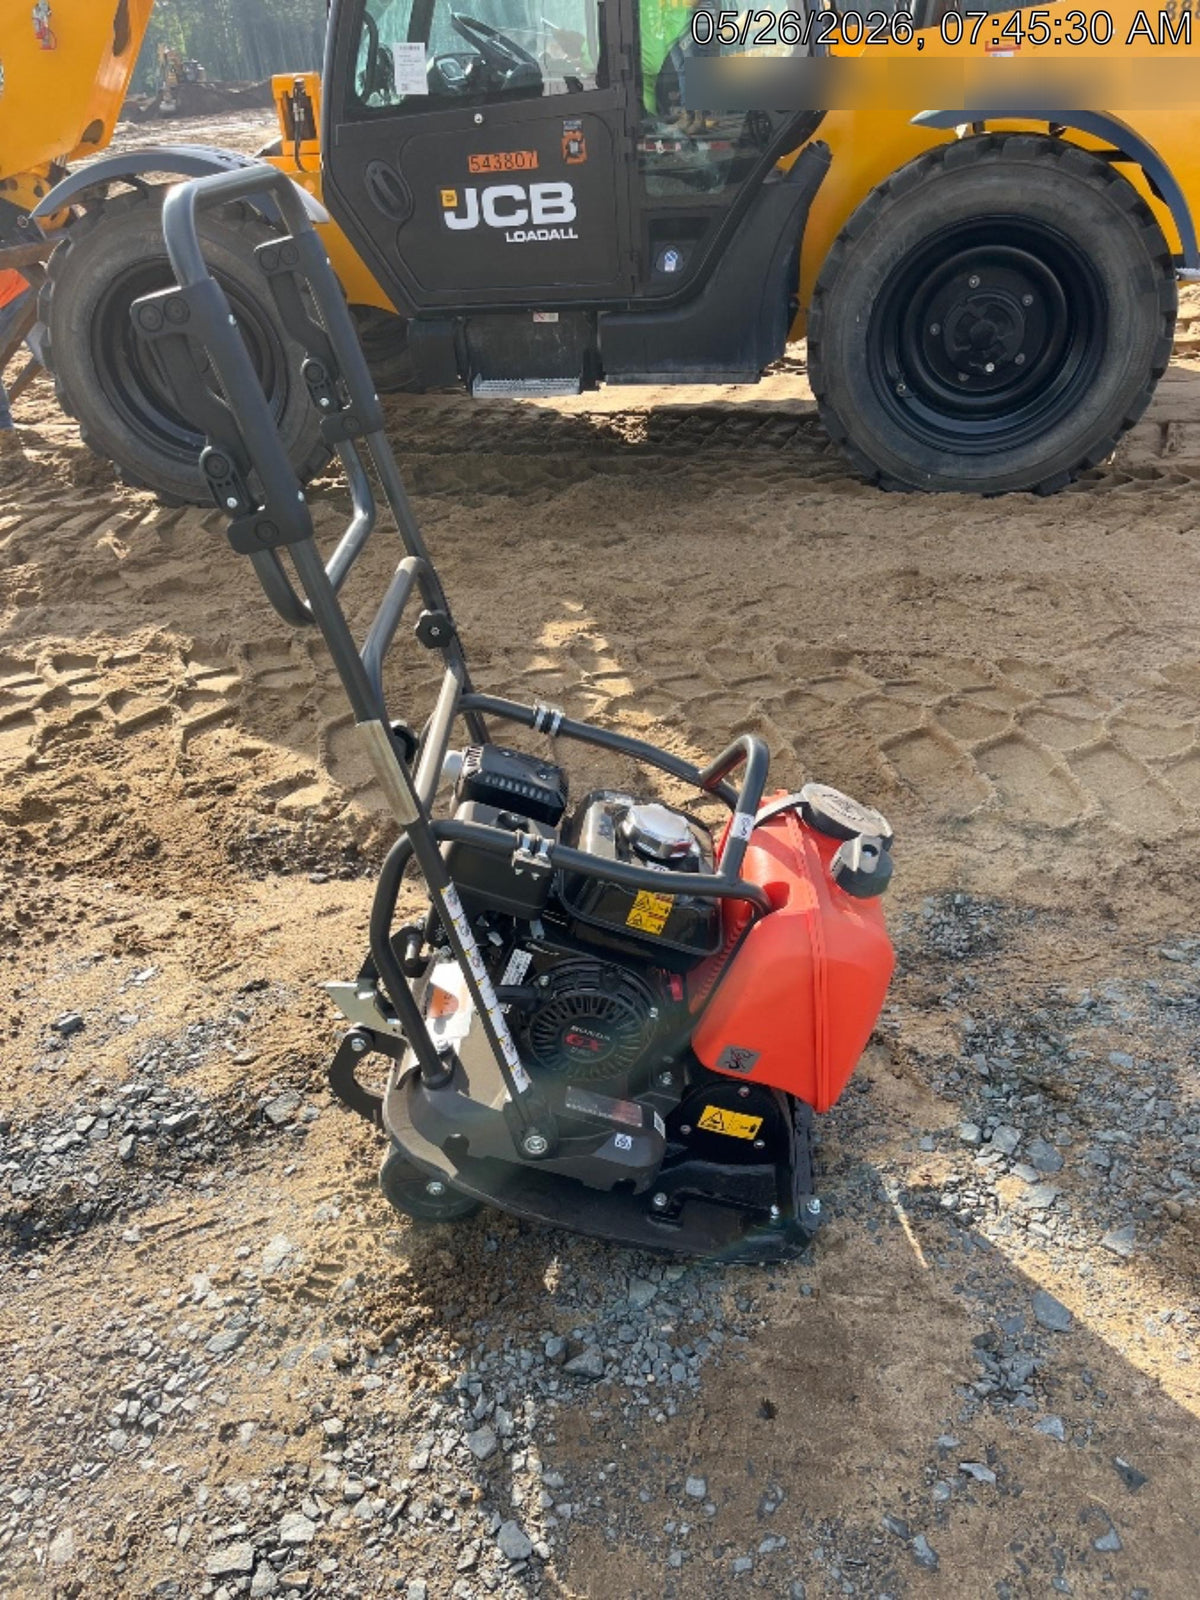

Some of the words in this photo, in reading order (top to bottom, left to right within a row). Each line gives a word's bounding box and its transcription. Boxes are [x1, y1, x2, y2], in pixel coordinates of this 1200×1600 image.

[469, 152, 537, 173] 543807
[443, 182, 577, 230] JCB
[505, 228, 578, 243] LOADALL
